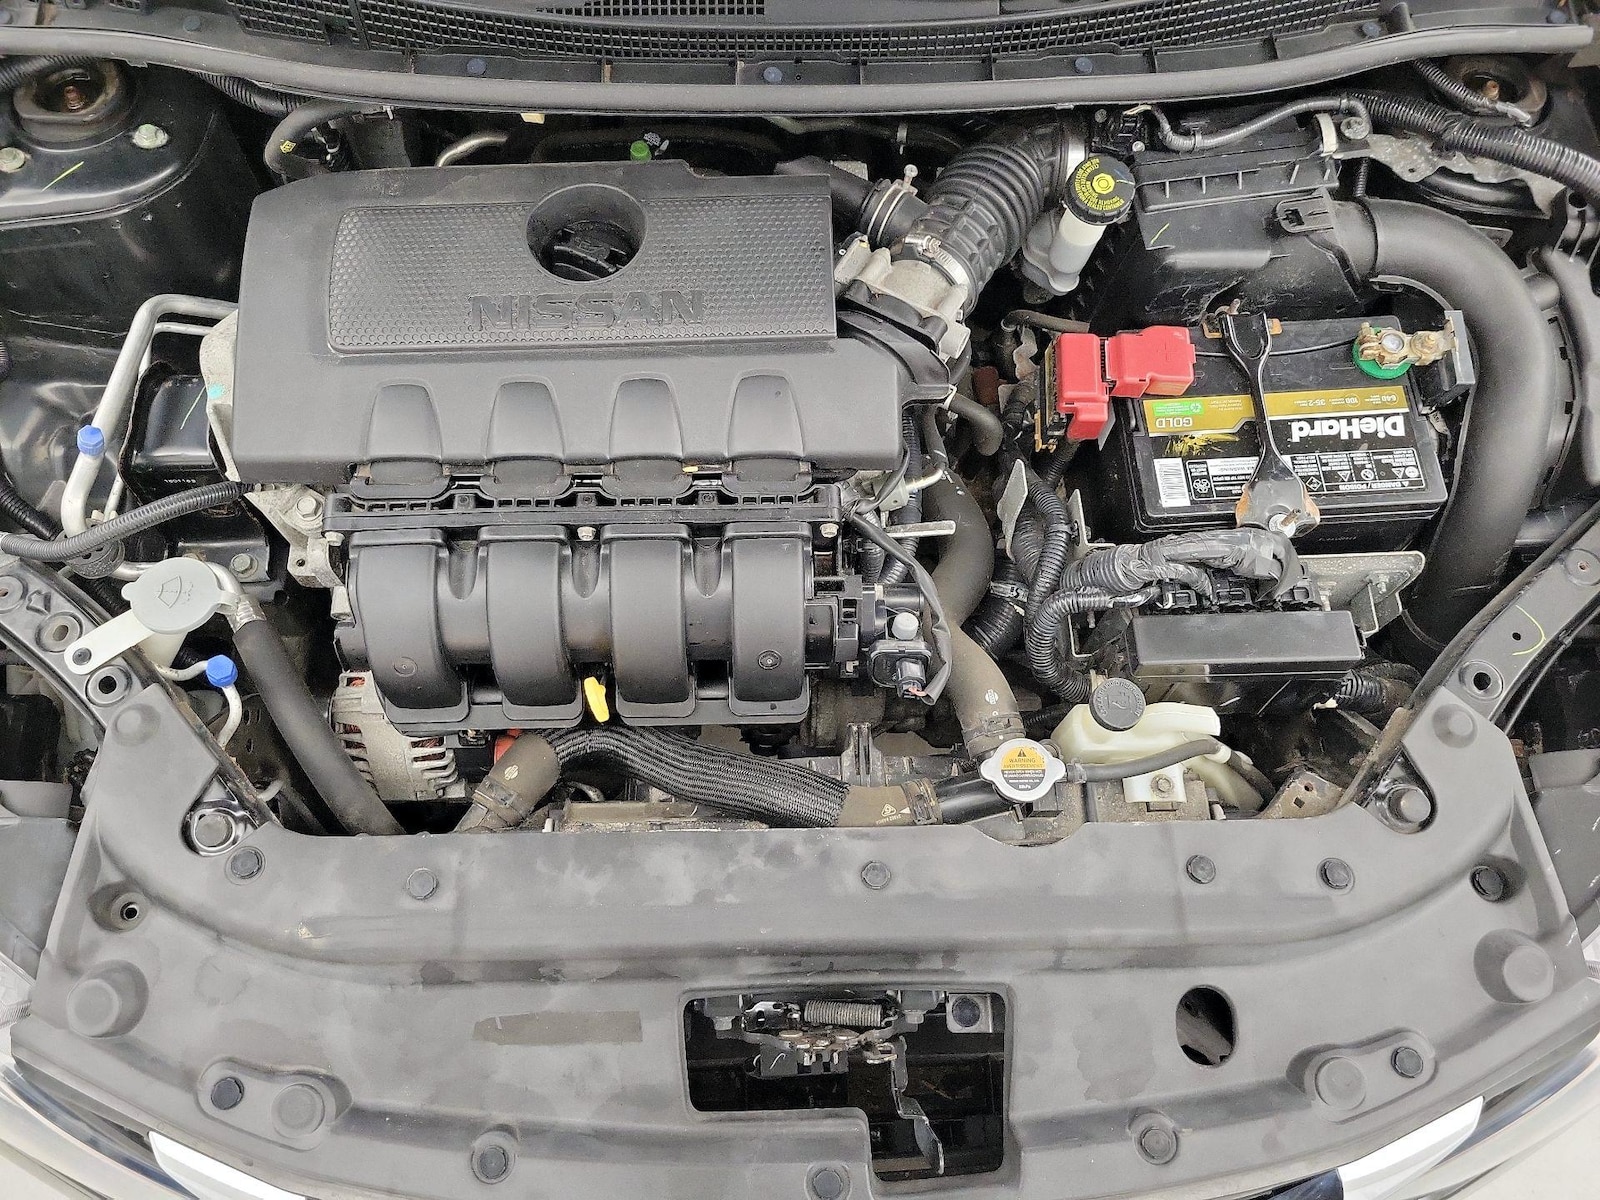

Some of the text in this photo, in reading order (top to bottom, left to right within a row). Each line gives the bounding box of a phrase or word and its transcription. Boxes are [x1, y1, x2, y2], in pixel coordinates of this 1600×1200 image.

[468, 290, 705, 331] NISSAN
[1155, 417, 1193, 428] GOLD
[1291, 415, 1406, 443] DieHard
[1371, 481, 1401, 489] DANGER
